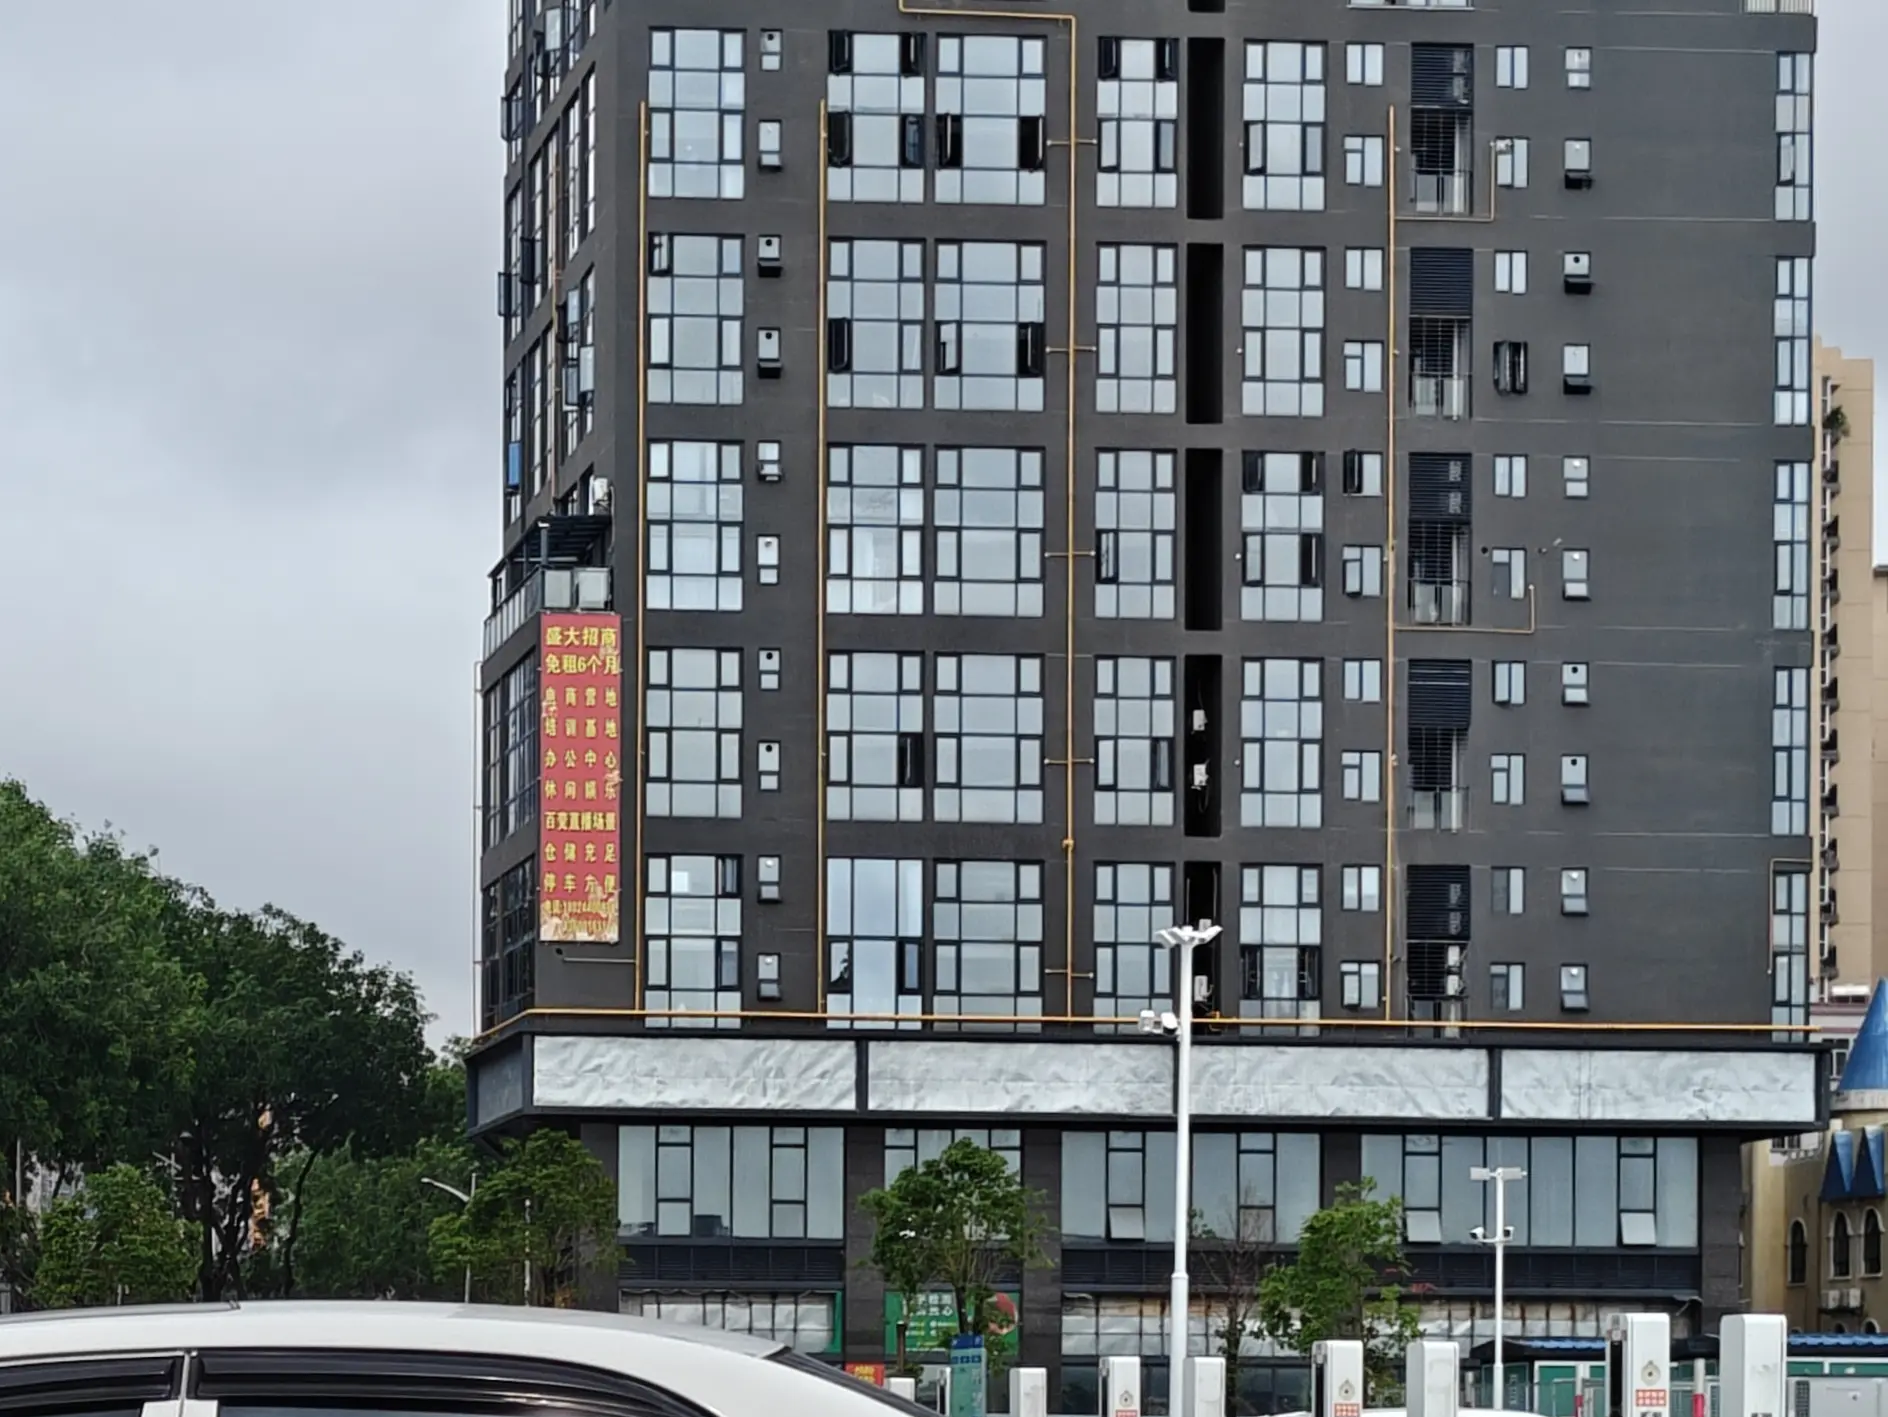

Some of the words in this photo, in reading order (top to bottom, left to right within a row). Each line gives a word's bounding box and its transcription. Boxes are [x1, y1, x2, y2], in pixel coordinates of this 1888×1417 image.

[545, 626, 618, 647] 盛大招商
[545, 653, 620, 675] 免租6个月
[544, 749, 617, 769] 办公中心
[544, 780, 617, 800] 休闲娱乐
[544, 842, 617, 863] 仓储充足
[544, 872, 617, 894] 停车方便
